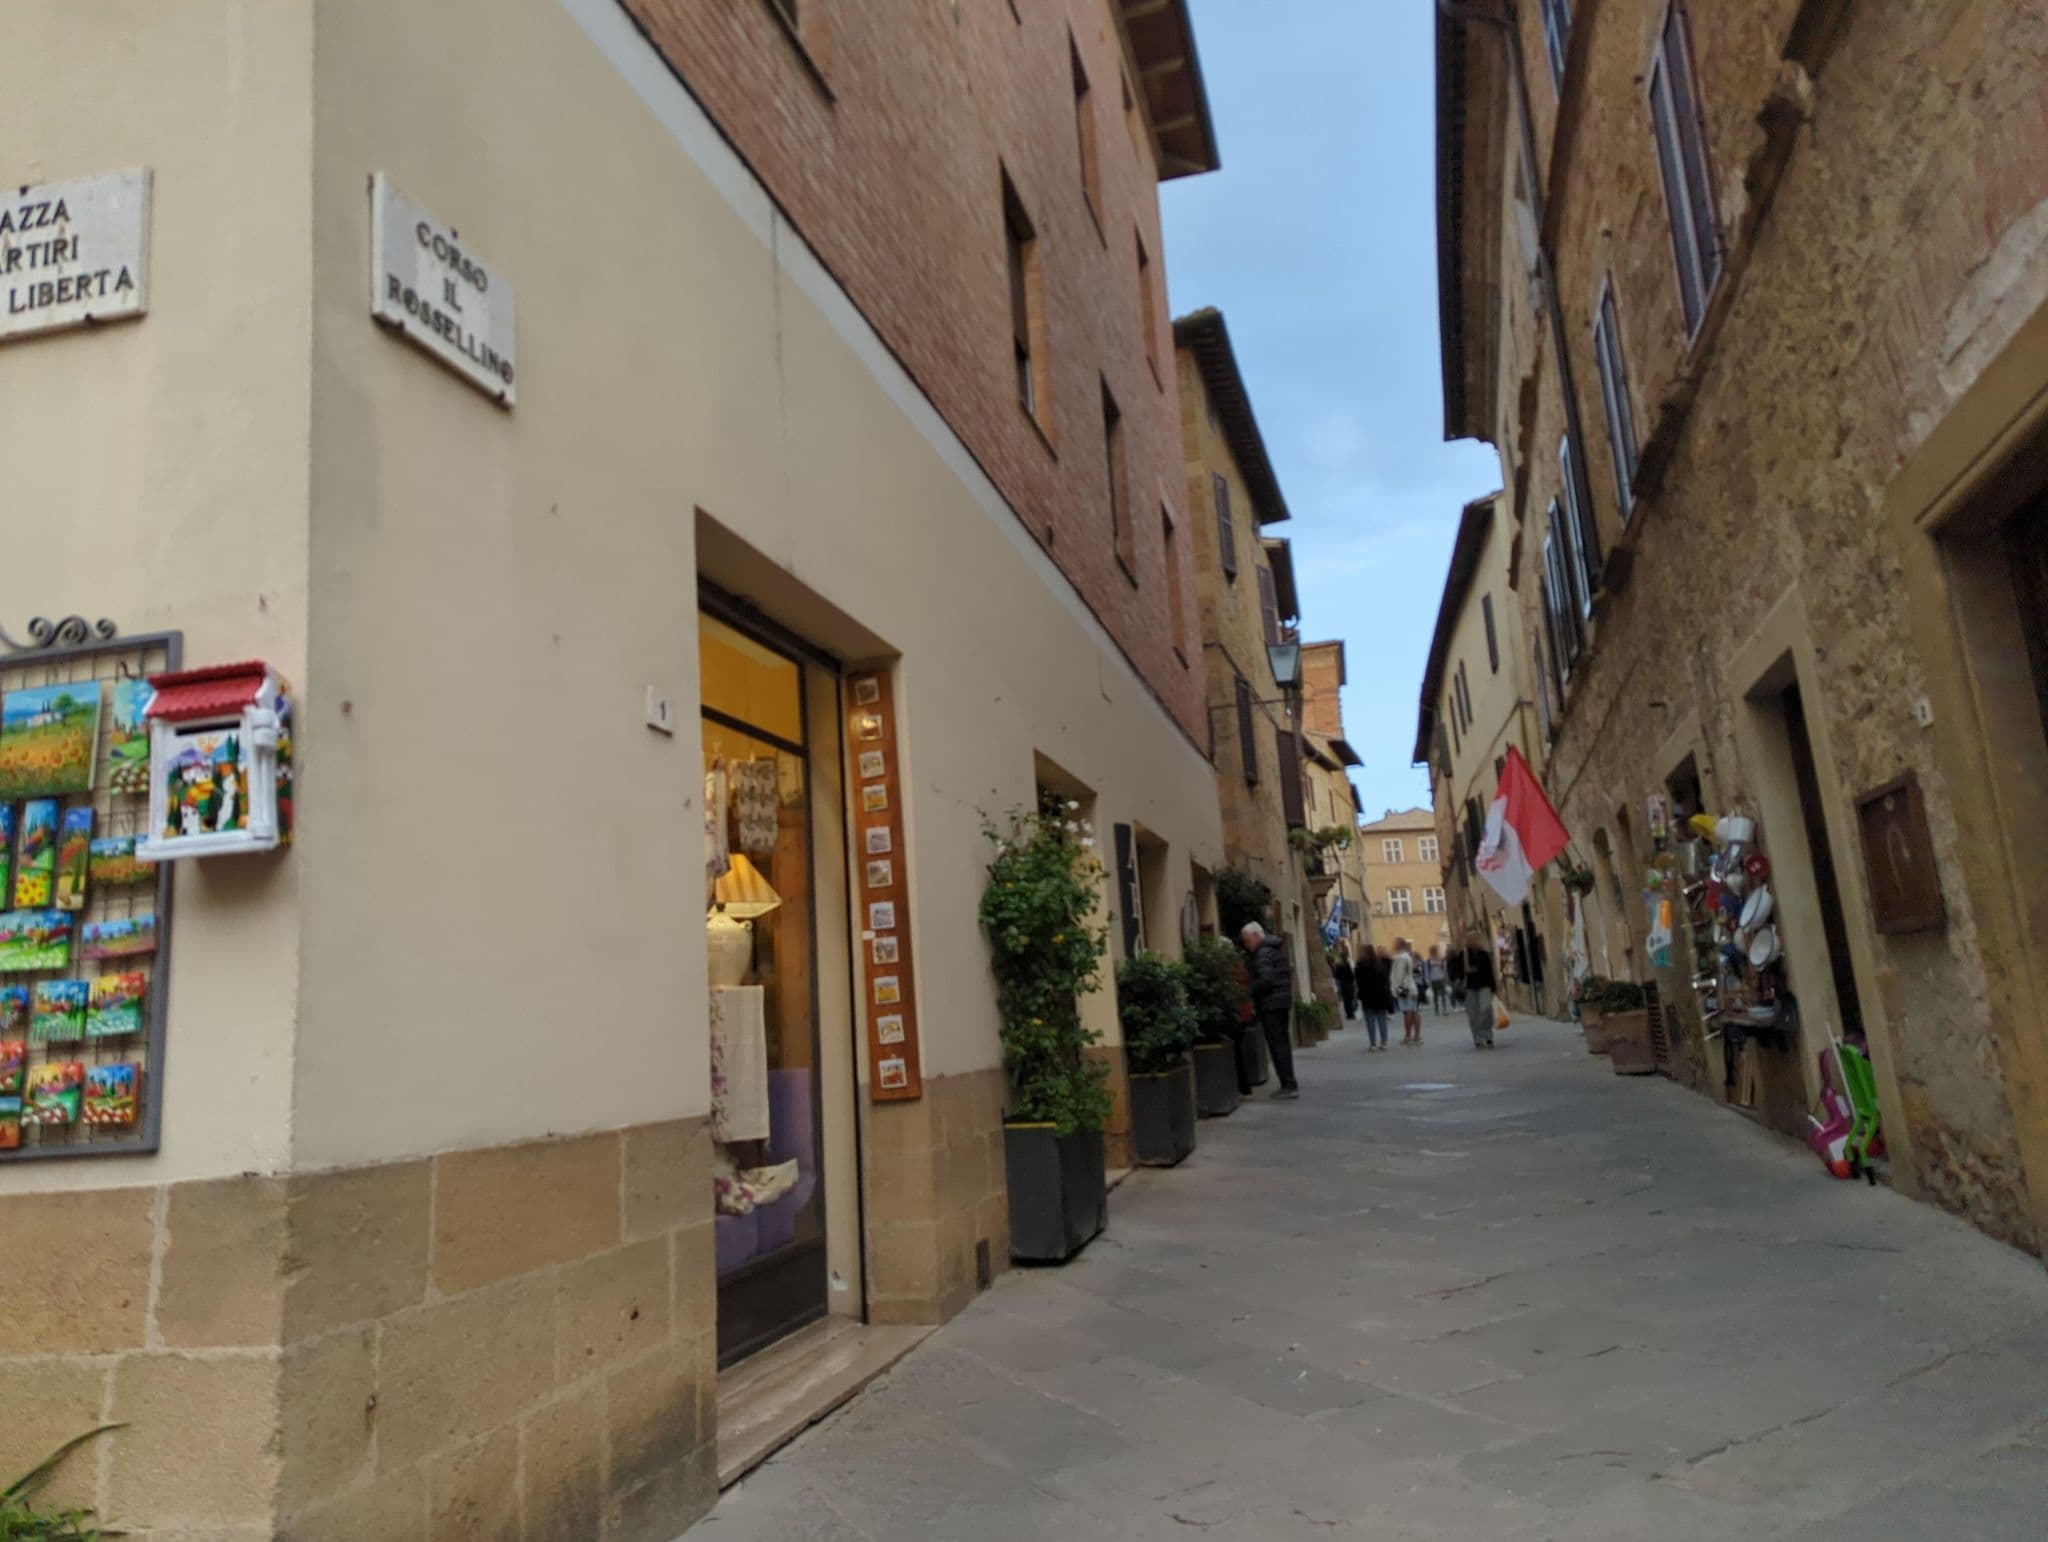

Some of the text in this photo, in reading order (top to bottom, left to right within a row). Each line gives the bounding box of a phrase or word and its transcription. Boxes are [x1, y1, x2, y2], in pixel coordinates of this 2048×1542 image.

[0, 234, 79, 275] RTIRI
[416, 221, 488, 293] CORSO
[9, 265, 134, 314] LIBERTA
[444, 277, 462, 313] IL
[387, 273, 513, 384] ROSSELLINO
